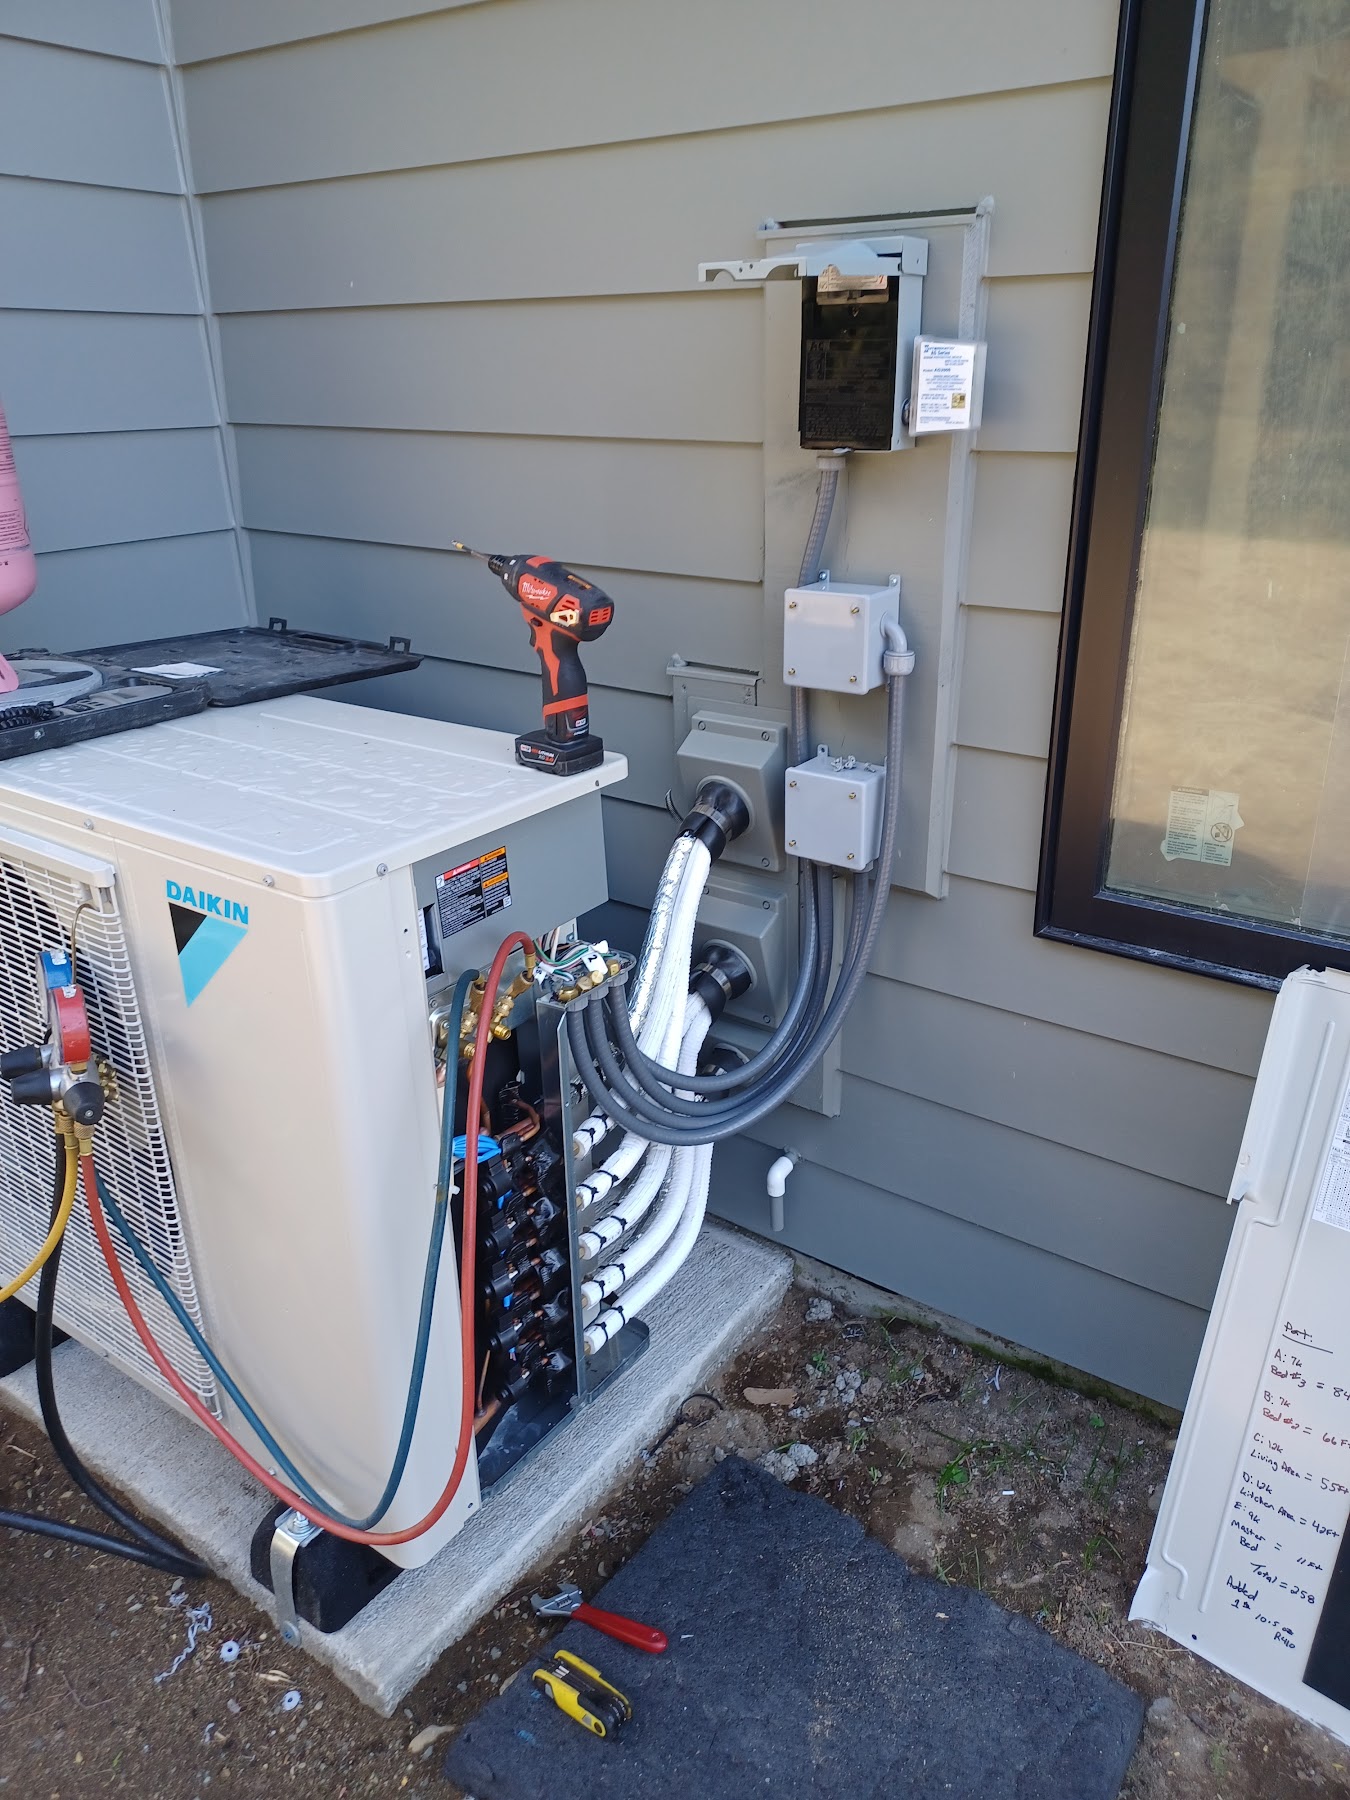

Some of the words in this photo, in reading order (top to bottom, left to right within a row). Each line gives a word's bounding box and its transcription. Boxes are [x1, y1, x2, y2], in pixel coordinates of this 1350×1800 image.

[522, 582, 551, 596] Milwaukee
[166, 880, 248, 924] DAIKIN
[1274, 1348, 1286, 1363] A:
[1271, 1364, 1288, 1378] Bed
[1264, 1390, 1274, 1405] B:
[1263, 1407, 1282, 1422] Bed
[1254, 1432, 1264, 1444] C:
[1250, 1449, 1278, 1472] Living
[1234, 1502, 1246, 1512] E:
[1230, 1520, 1266, 1541] Master
[1240, 1536, 1258, 1551] Bed
[1226, 1575, 1258, 1602] Added
[1250, 1562, 1278, 1584] Total
[1290, 1586, 1315, 1604] 258
[1255, 1614, 1280, 1627] 10.5
[1274, 1631, 1296, 1648] R410
